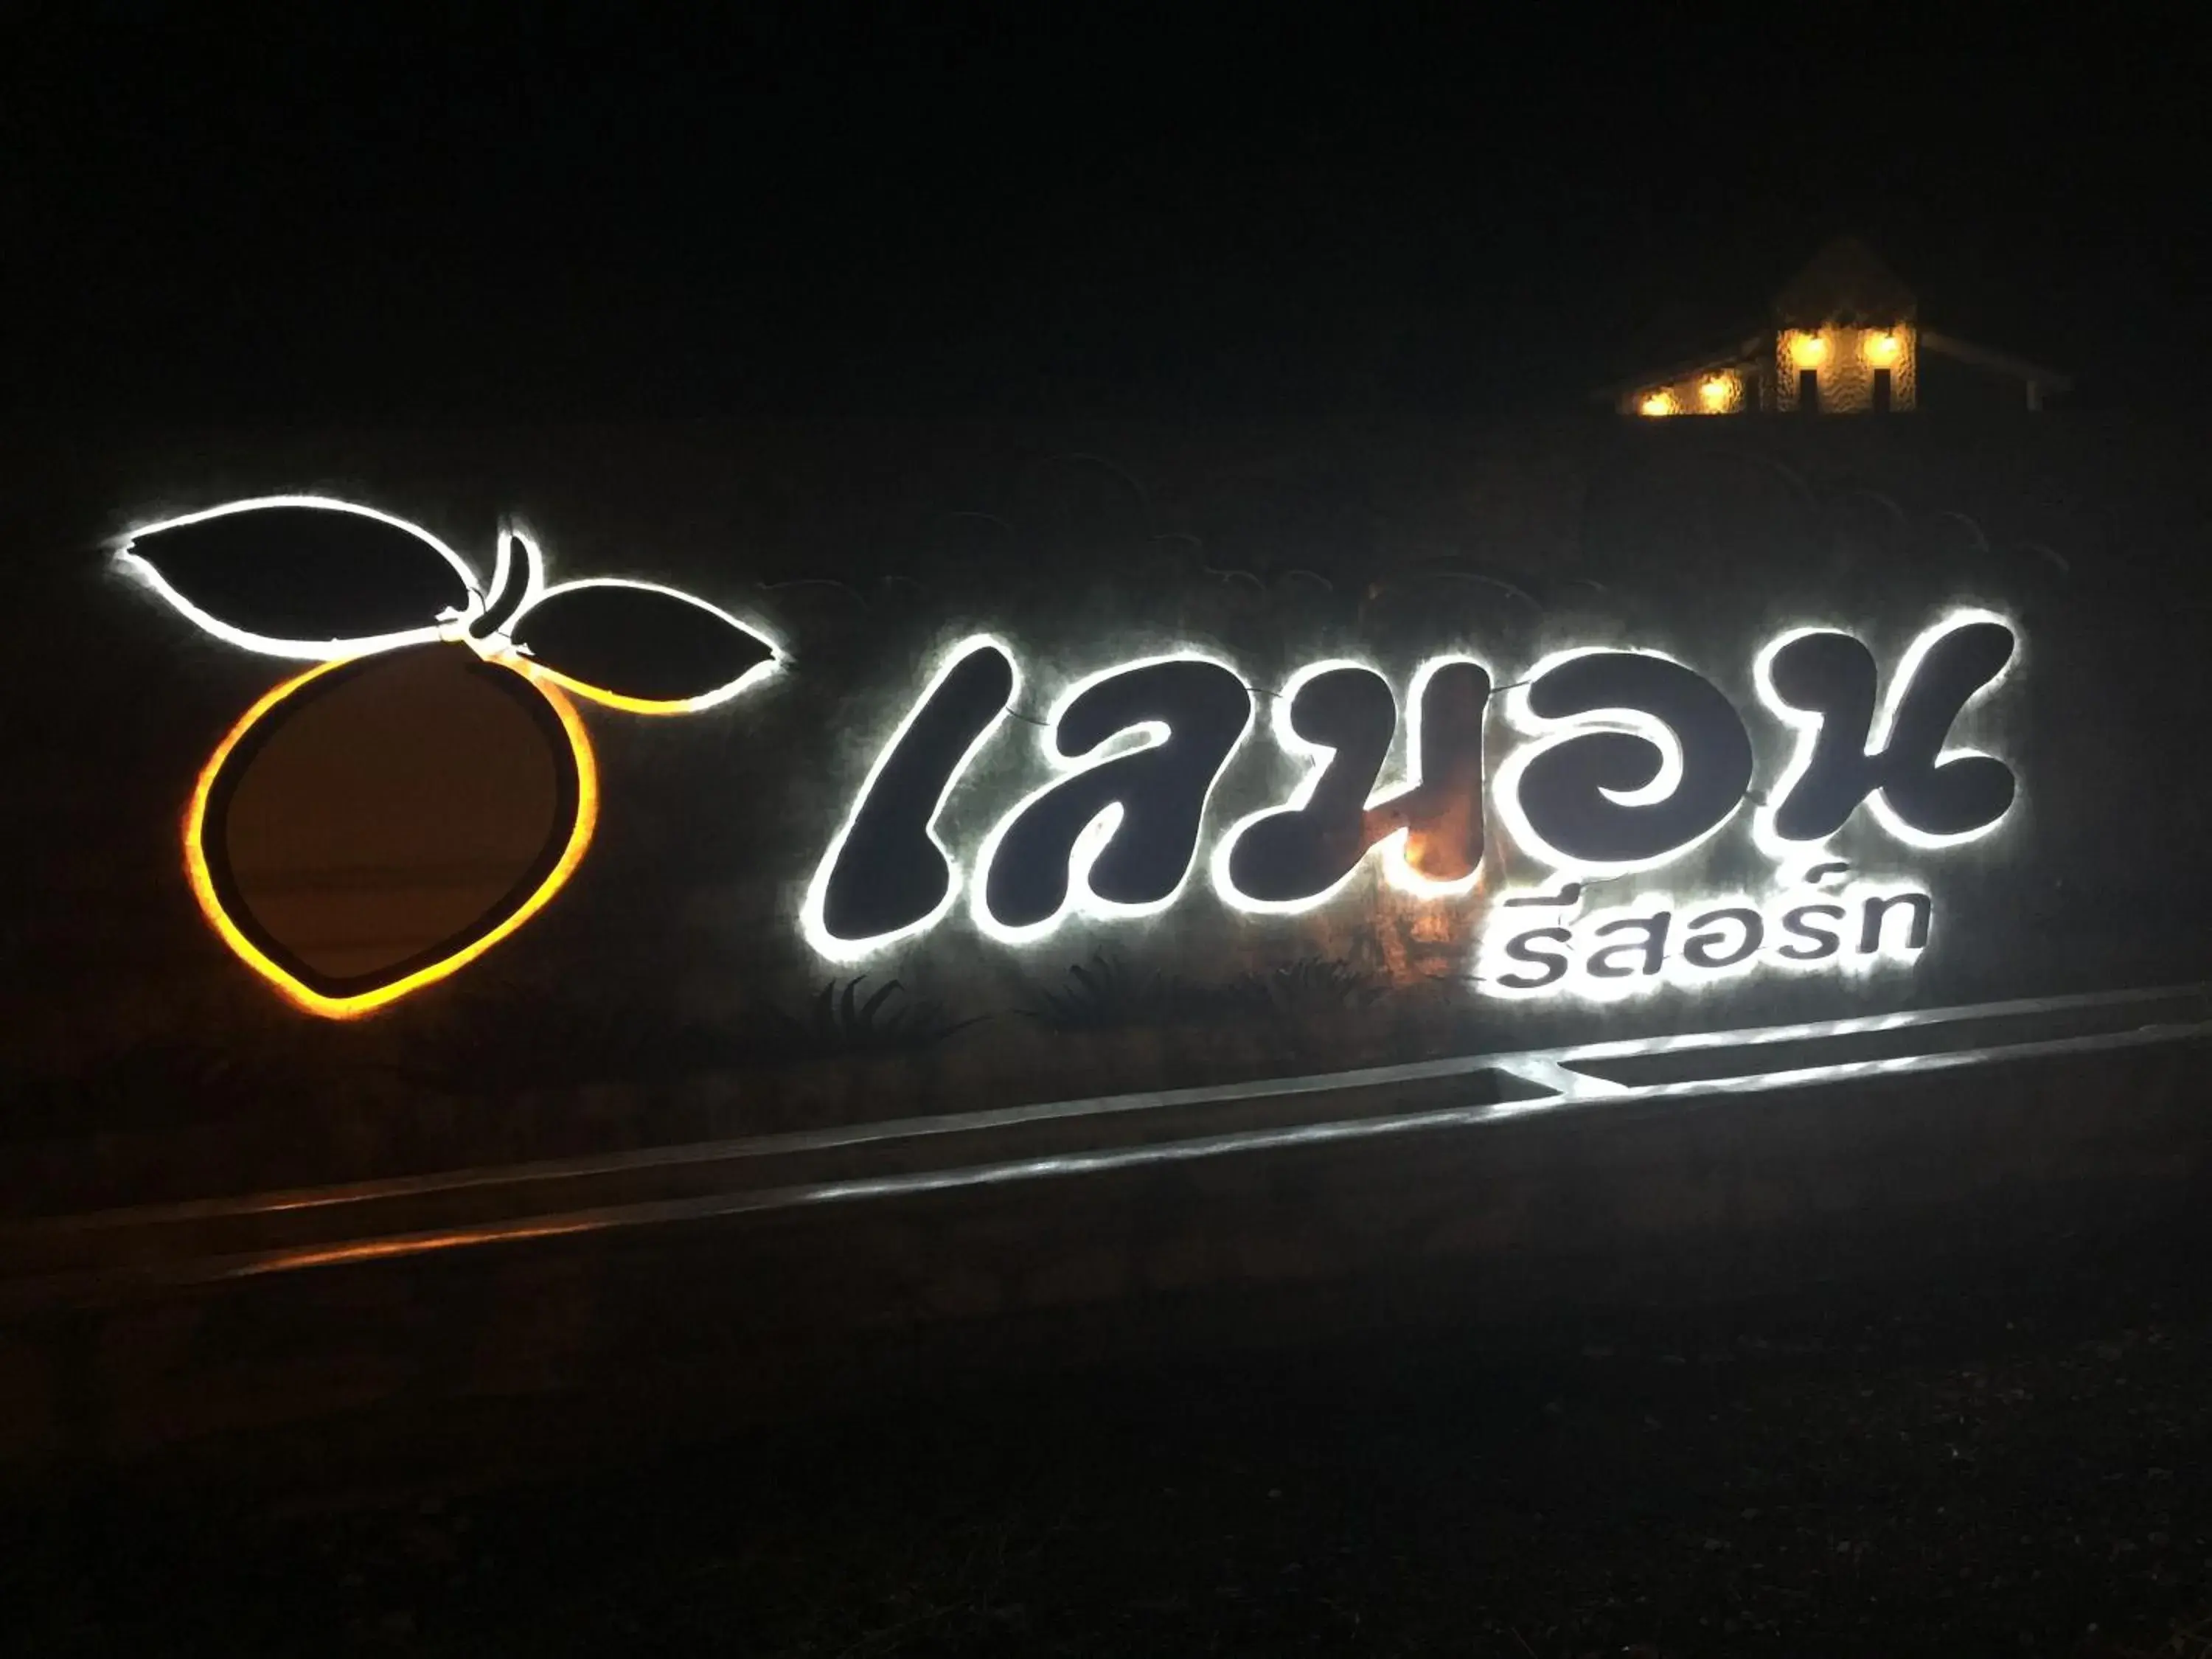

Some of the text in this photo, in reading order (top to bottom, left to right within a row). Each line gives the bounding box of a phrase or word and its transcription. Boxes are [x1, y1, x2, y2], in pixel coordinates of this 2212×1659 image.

[818, 616, 2017, 944] เลมอน
[1495, 861, 1933, 990] รีสอร์ท
